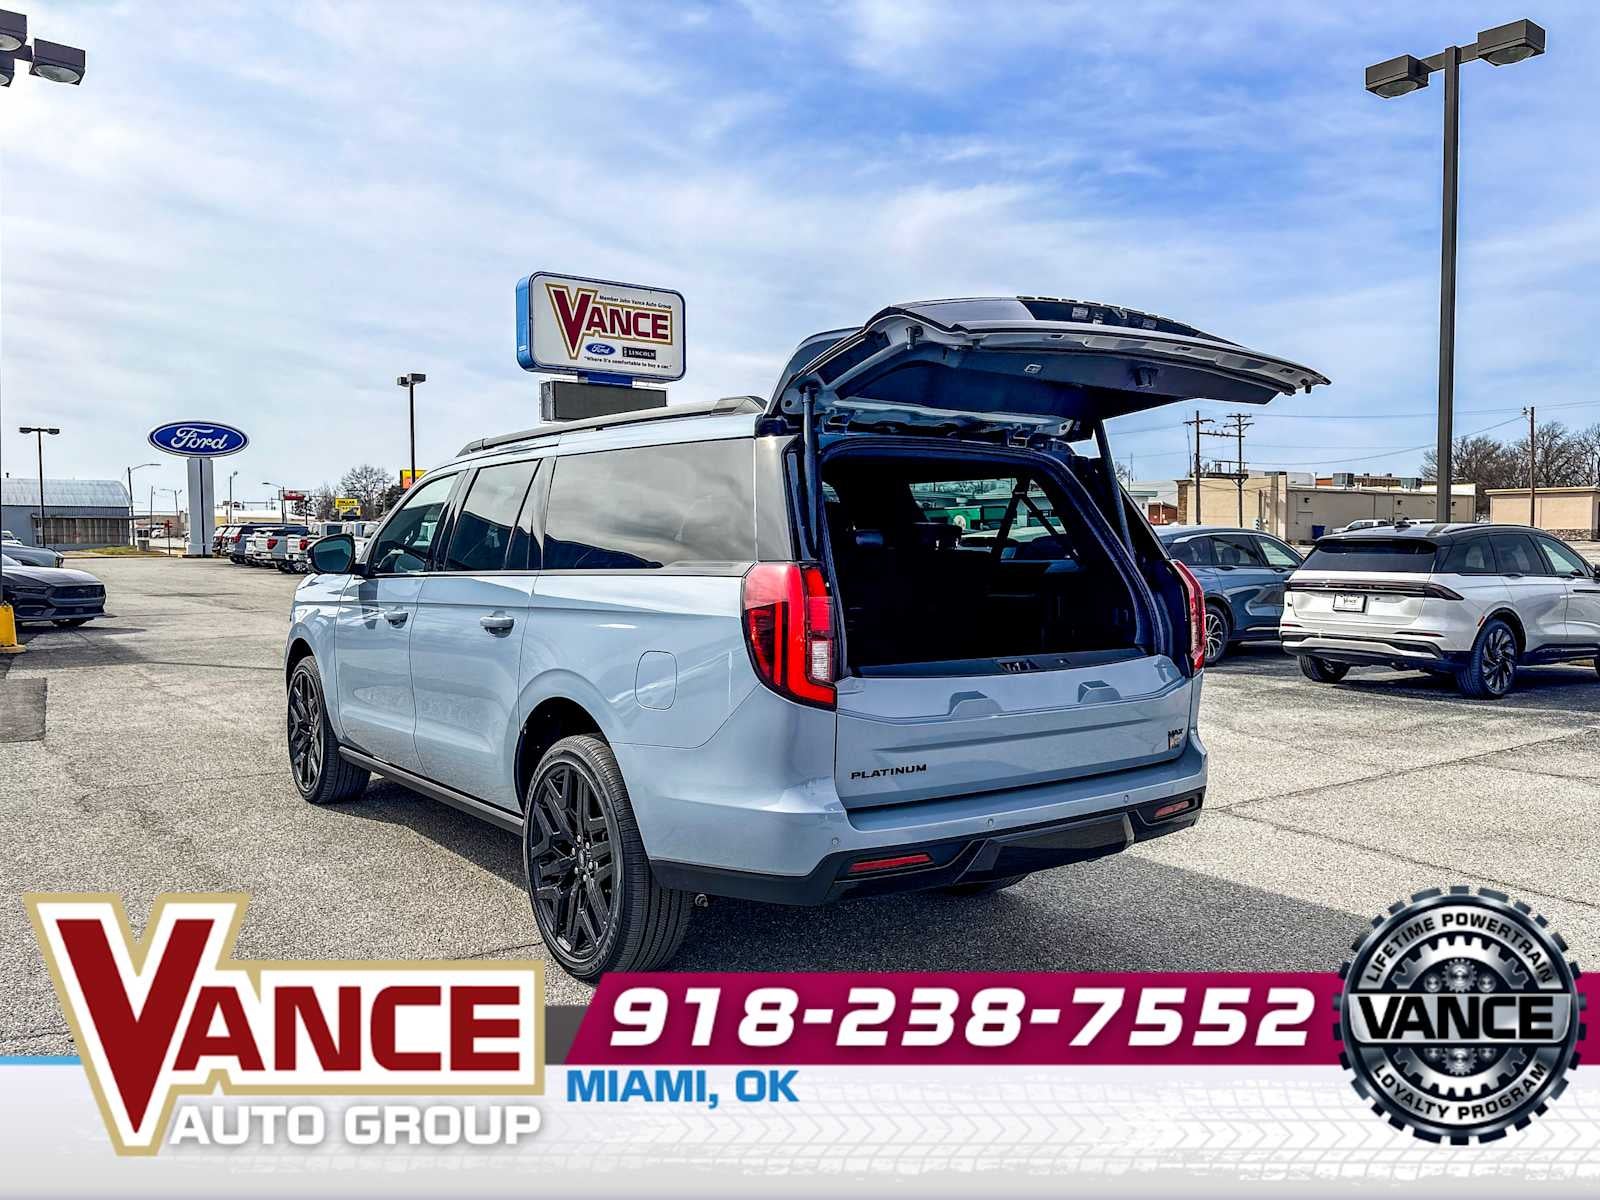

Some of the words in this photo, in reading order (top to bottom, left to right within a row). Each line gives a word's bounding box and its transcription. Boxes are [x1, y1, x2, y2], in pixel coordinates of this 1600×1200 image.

[552, 289, 669, 353] VANCE
[591, 344, 610, 355] Ford
[628, 349, 655, 358] LINCOLN
[170, 427, 228, 449] Ford
[851, 764, 927, 780] PLATINUM
